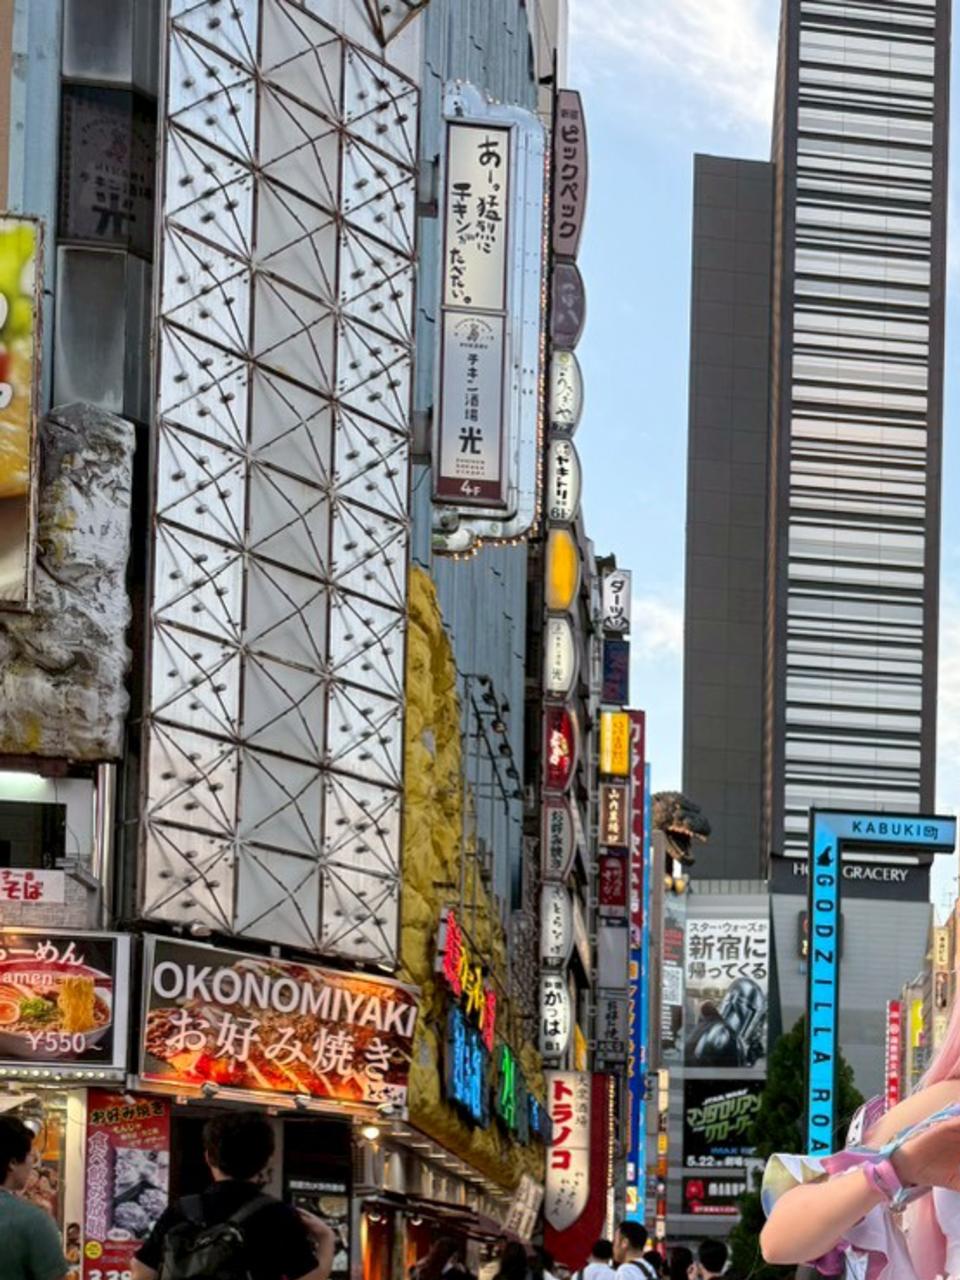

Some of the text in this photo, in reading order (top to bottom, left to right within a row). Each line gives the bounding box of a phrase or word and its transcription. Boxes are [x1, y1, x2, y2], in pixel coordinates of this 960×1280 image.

[459, 426, 483, 454] 光
[460, 480, 481, 496] 4F
[843, 865, 908, 881] GRACERY
[2, 881, 43, 900] そば
[689, 934, 767, 960] 新宿に
[689, 962, 767, 980] 帰ってくる
[153, 961, 418, 1038] OKONOMIYAKI
[811, 874, 835, 1152] GODZILLA ROA
[165, 1008, 393, 1083] お好み焼き
[552, 1079, 573, 1170] トラノコ
